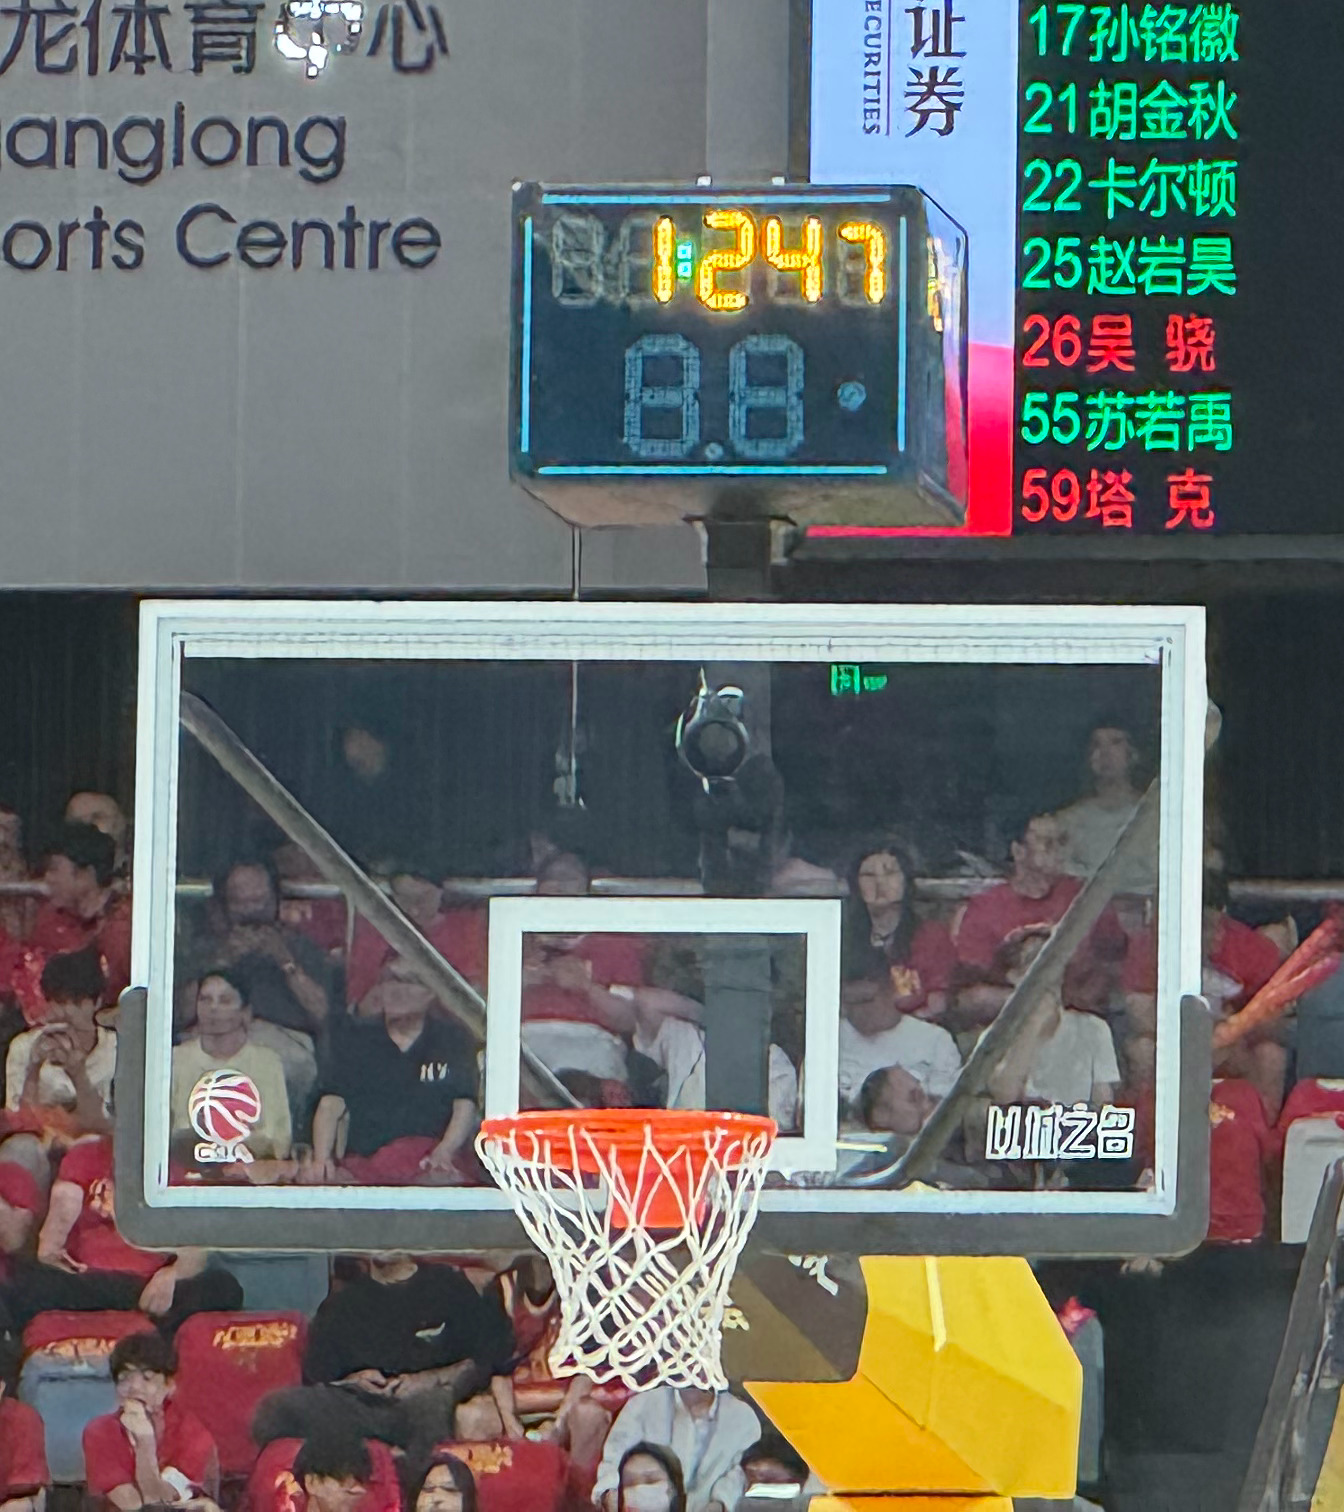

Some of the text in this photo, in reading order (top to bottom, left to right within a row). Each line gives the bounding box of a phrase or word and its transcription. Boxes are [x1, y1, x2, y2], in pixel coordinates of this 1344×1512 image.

[0, 101, 347, 188] anglong
[2, 202, 442, 273] orts Centre
